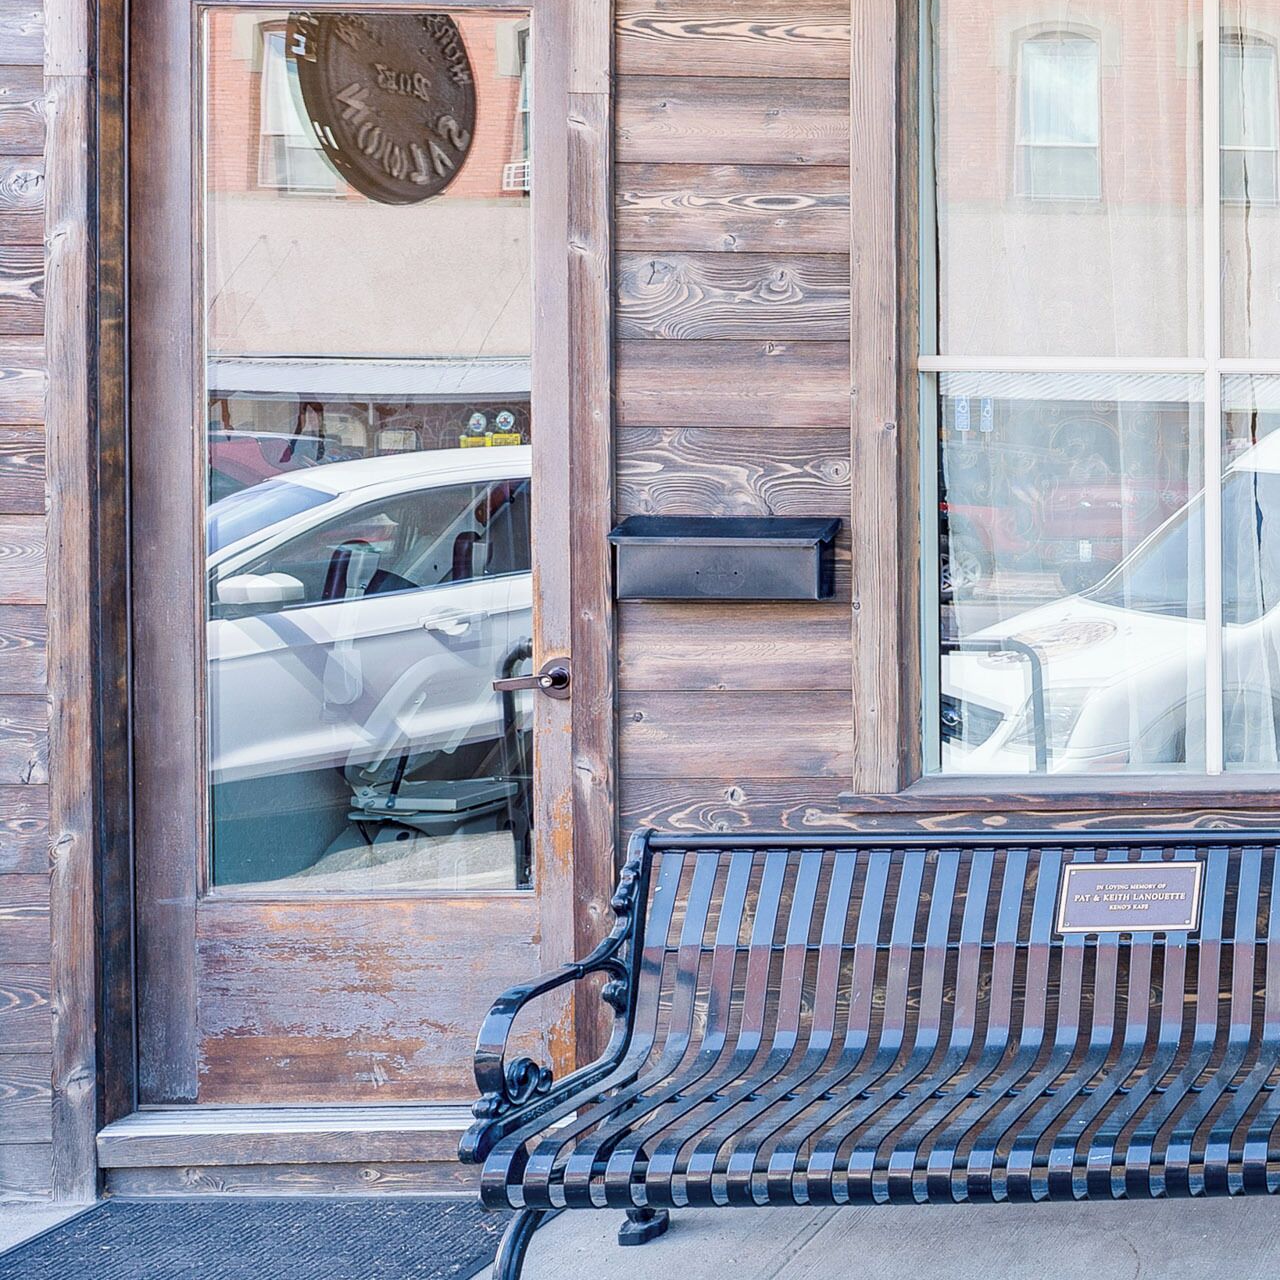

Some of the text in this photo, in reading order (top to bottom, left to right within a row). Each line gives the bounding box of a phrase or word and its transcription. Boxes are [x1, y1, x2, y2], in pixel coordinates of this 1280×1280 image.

[1074, 892, 1186, 902] PAT & KEITH LANOUETTE
